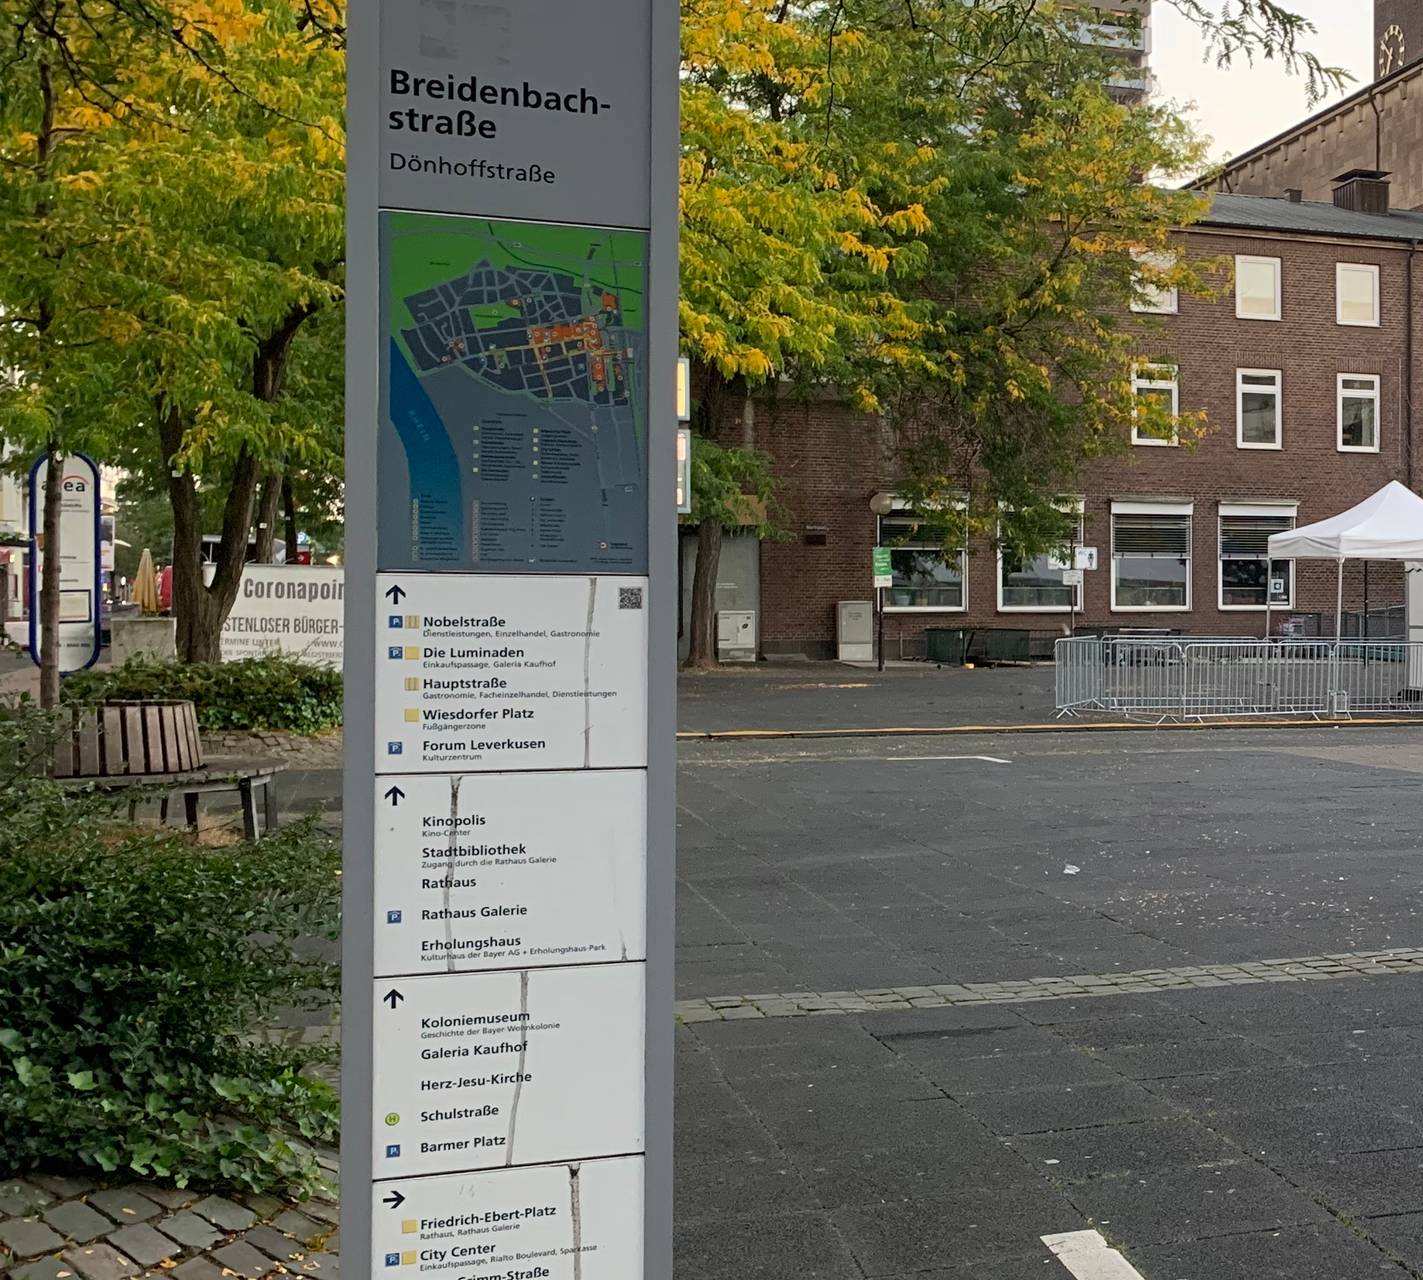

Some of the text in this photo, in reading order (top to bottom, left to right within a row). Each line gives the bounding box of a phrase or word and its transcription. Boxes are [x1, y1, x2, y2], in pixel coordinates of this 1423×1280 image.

[390, 69, 611, 115] Breidenbach-
[389, 110, 496, 138] straße
[390, 153, 555, 184] Dönhoffstraße
[41, 481, 85, 492] aea
[423, 616, 505, 628] Nobelstraße
[423, 630, 600, 638] Dienstleistungen, Einzelhandel, Gastronomie
[423, 647, 445, 658] Die
[450, 647, 525, 658] Luminaden
[423, 660, 491, 669] Einkaufspassage,
[524, 660, 556, 668] Kaufhof
[423, 678, 507, 691] Hauptstraße
[423, 691, 617, 700] Gastronomie, Facheinzelhandel, Dienstleistungen
[423, 708, 534, 720] Wiesdorfer Platz
[423, 722, 486, 731] Fußgängerzone
[423, 741, 465, 751] Forum
[471, 739, 546, 751] Leverkusen
[423, 753, 482, 761] Kulturzentrum
[423, 815, 486, 828] Kinopolis
[422, 829, 470, 837] Kino-Center
[422, 844, 526, 858] Stadtbibliothek
[422, 861, 453, 869] Zugang
[495, 857, 527, 865] Rathaus
[529, 856, 556, 864] Galerie
[422, 877, 476, 889] Rathaus
[422, 908, 476, 920] Rathaus
[481, 905, 527, 917] Galerie
[422, 936, 521, 951] Erholungshaus
[421, 952, 465, 962] Kulturhaus
[468, 951, 481, 959] der
[483, 950, 506, 959] Bayer
[530, 943, 605, 956] Erholungshaus-Park
[422, 1012, 530, 1029] Koloniemuseum
[421, 1029, 464, 1039] Geschichte
[467, 1028, 480, 1036] der
[421, 1041, 528, 1060] Galeria Kaufhof
[421, 1072, 532, 1091] Herz-Jesu-Kirche
[421, 1105, 499, 1122] Schulstraße
[420, 1138, 470, 1153] Barmer
[474, 1135, 506, 1148] Platz
[420, 1205, 556, 1230] Friedrich-Ebert-Platz
[420, 1222, 520, 1241] Rathaus, Rathaus Galerie
[420, 1247, 446, 1262] City
[451, 1243, 496, 1258] Center
[419, 1257, 488, 1272] Einkaufspassage,
[490, 1252, 514, 1263] Rialto
[516, 1248, 558, 1262] Boulevard,
